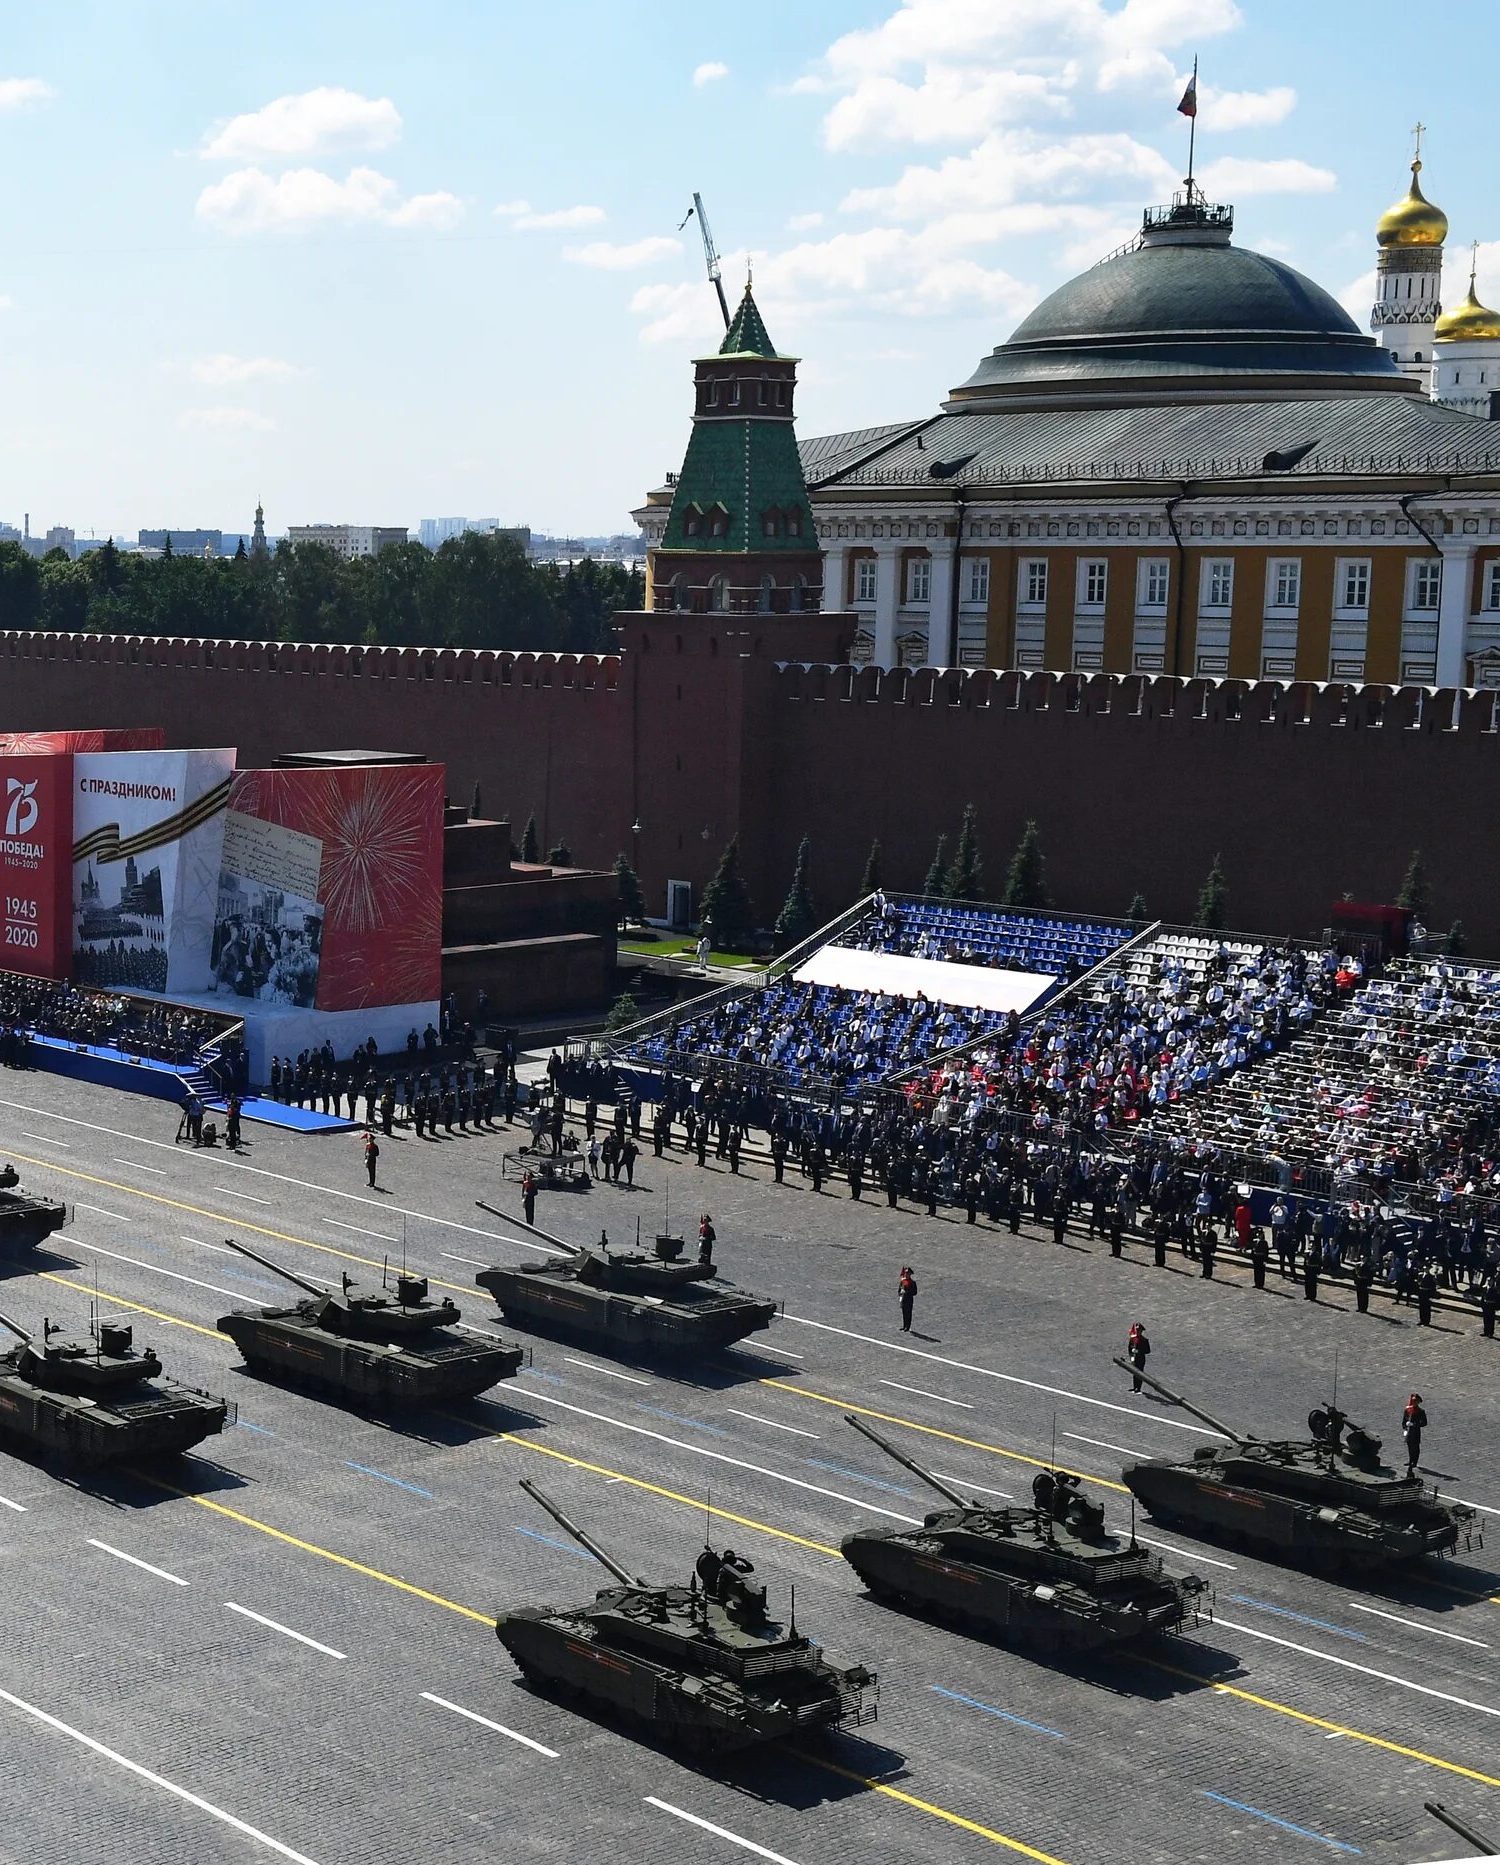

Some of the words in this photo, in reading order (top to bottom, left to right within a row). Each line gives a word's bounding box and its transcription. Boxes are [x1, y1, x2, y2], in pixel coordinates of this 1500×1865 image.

[80, 779, 87, 793] С
[89, 778, 176, 802] ПРАЗДНИКОМ!
[5, 777, 39, 835] 75
[0, 839, 44, 859] ПОБЕДА!
[5, 896, 37, 919] 1945
[4, 925, 38, 949] 2020
